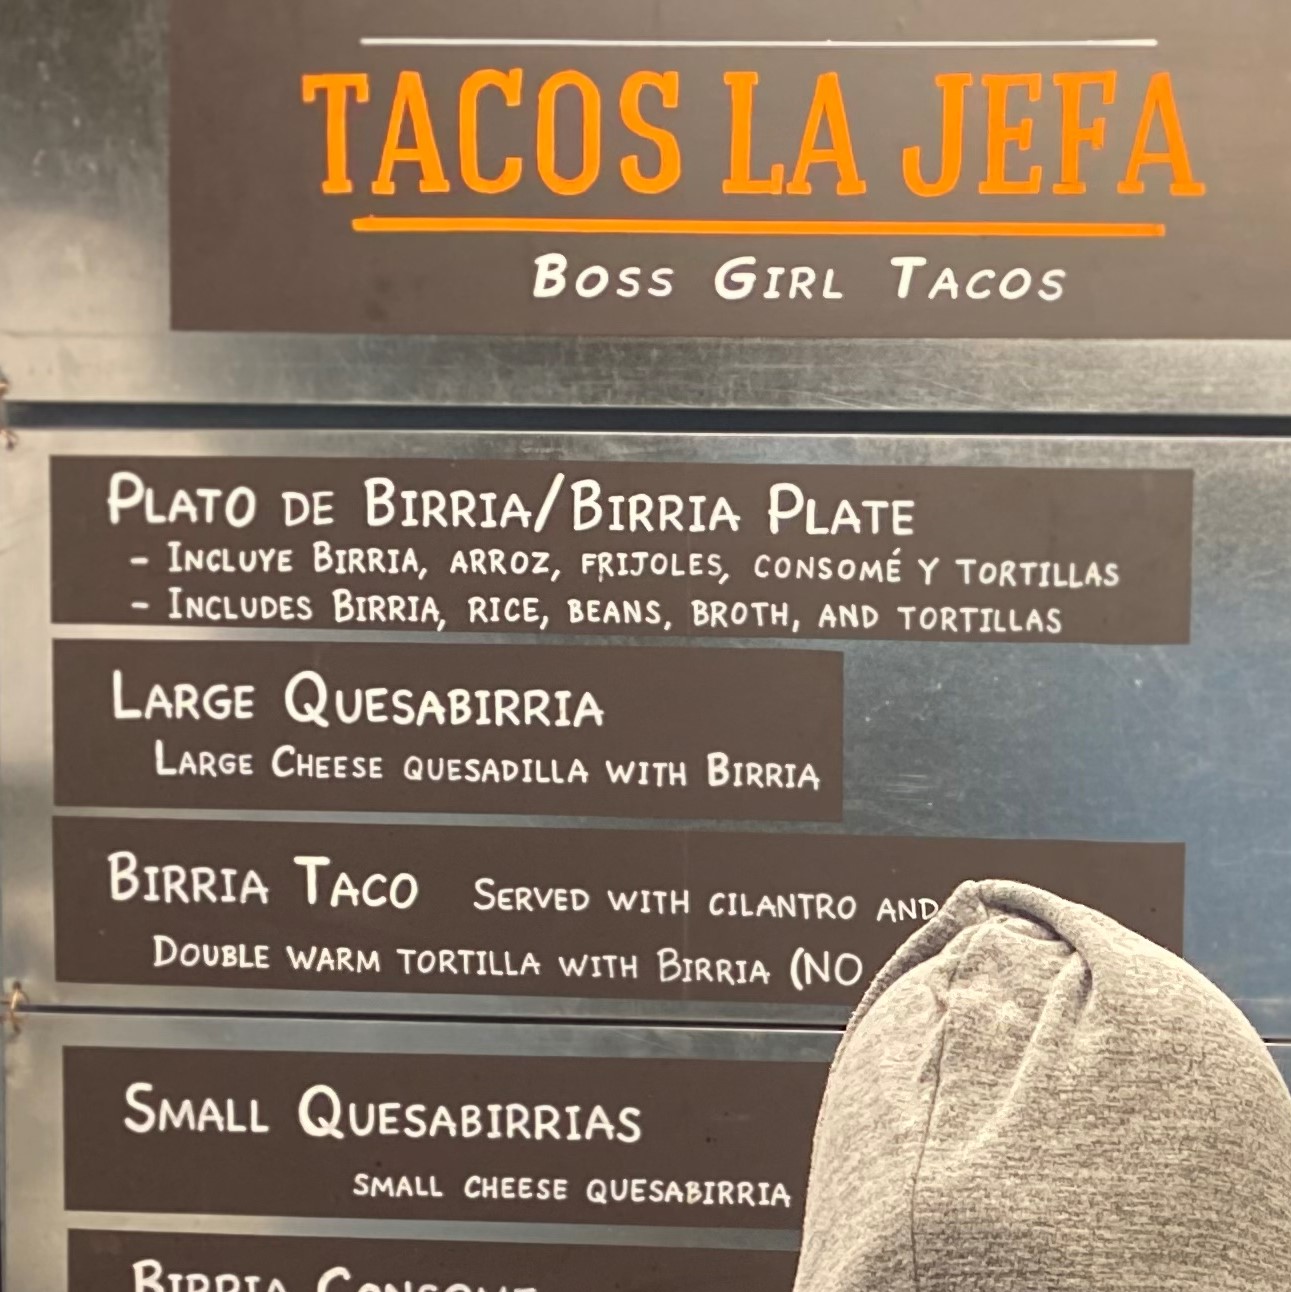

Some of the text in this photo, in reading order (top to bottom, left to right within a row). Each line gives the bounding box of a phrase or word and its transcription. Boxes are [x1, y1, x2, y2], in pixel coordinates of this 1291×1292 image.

[300, 66, 1207, 199] TACOS LA JEFA
[532, 252, 1067, 302] BOSS GIRL TACOS
[106, 471, 915, 536] PLATO DE BIRRIA/BIRRIA PLATE
[167, 540, 293, 573] INCLUYE
[312, 540, 428, 581] BIRRIA,
[449, 548, 561, 583] ARROZ,
[581, 551, 730, 585] FRIJOLES,
[754, 547, 902, 583] CONSOMÉ
[917, 557, 940, 586] Y
[954, 558, 1120, 589] TORTILLAS
[168, 586, 313, 621] INCLUDES
[331, 588, 446, 632] BIRRIA,
[467, 596, 549, 630] RICE,
[566, 598, 672, 631] BEANS,
[690, 599, 800, 633] BROTH,
[817, 603, 879, 629] AND
[896, 605, 1062, 635] TORTILLAS
[112, 669, 605, 728] LARGE QUESABIRRIA
[154, 739, 821, 791] LARGE CHEESE QUESADILLA WITH BIRRIA
[107, 850, 938, 922] BIRRIA TACO SERVED WITH CILANTRO AND
[152, 934, 863, 992] DOUBLE WARM TORTILLA WITH BIRRIA (NO
[123, 1081, 642, 1144] SMALL QUESABIRRIAS
[352, 1172, 792, 1208] SMALL CHEESE QUESABIRRIA
